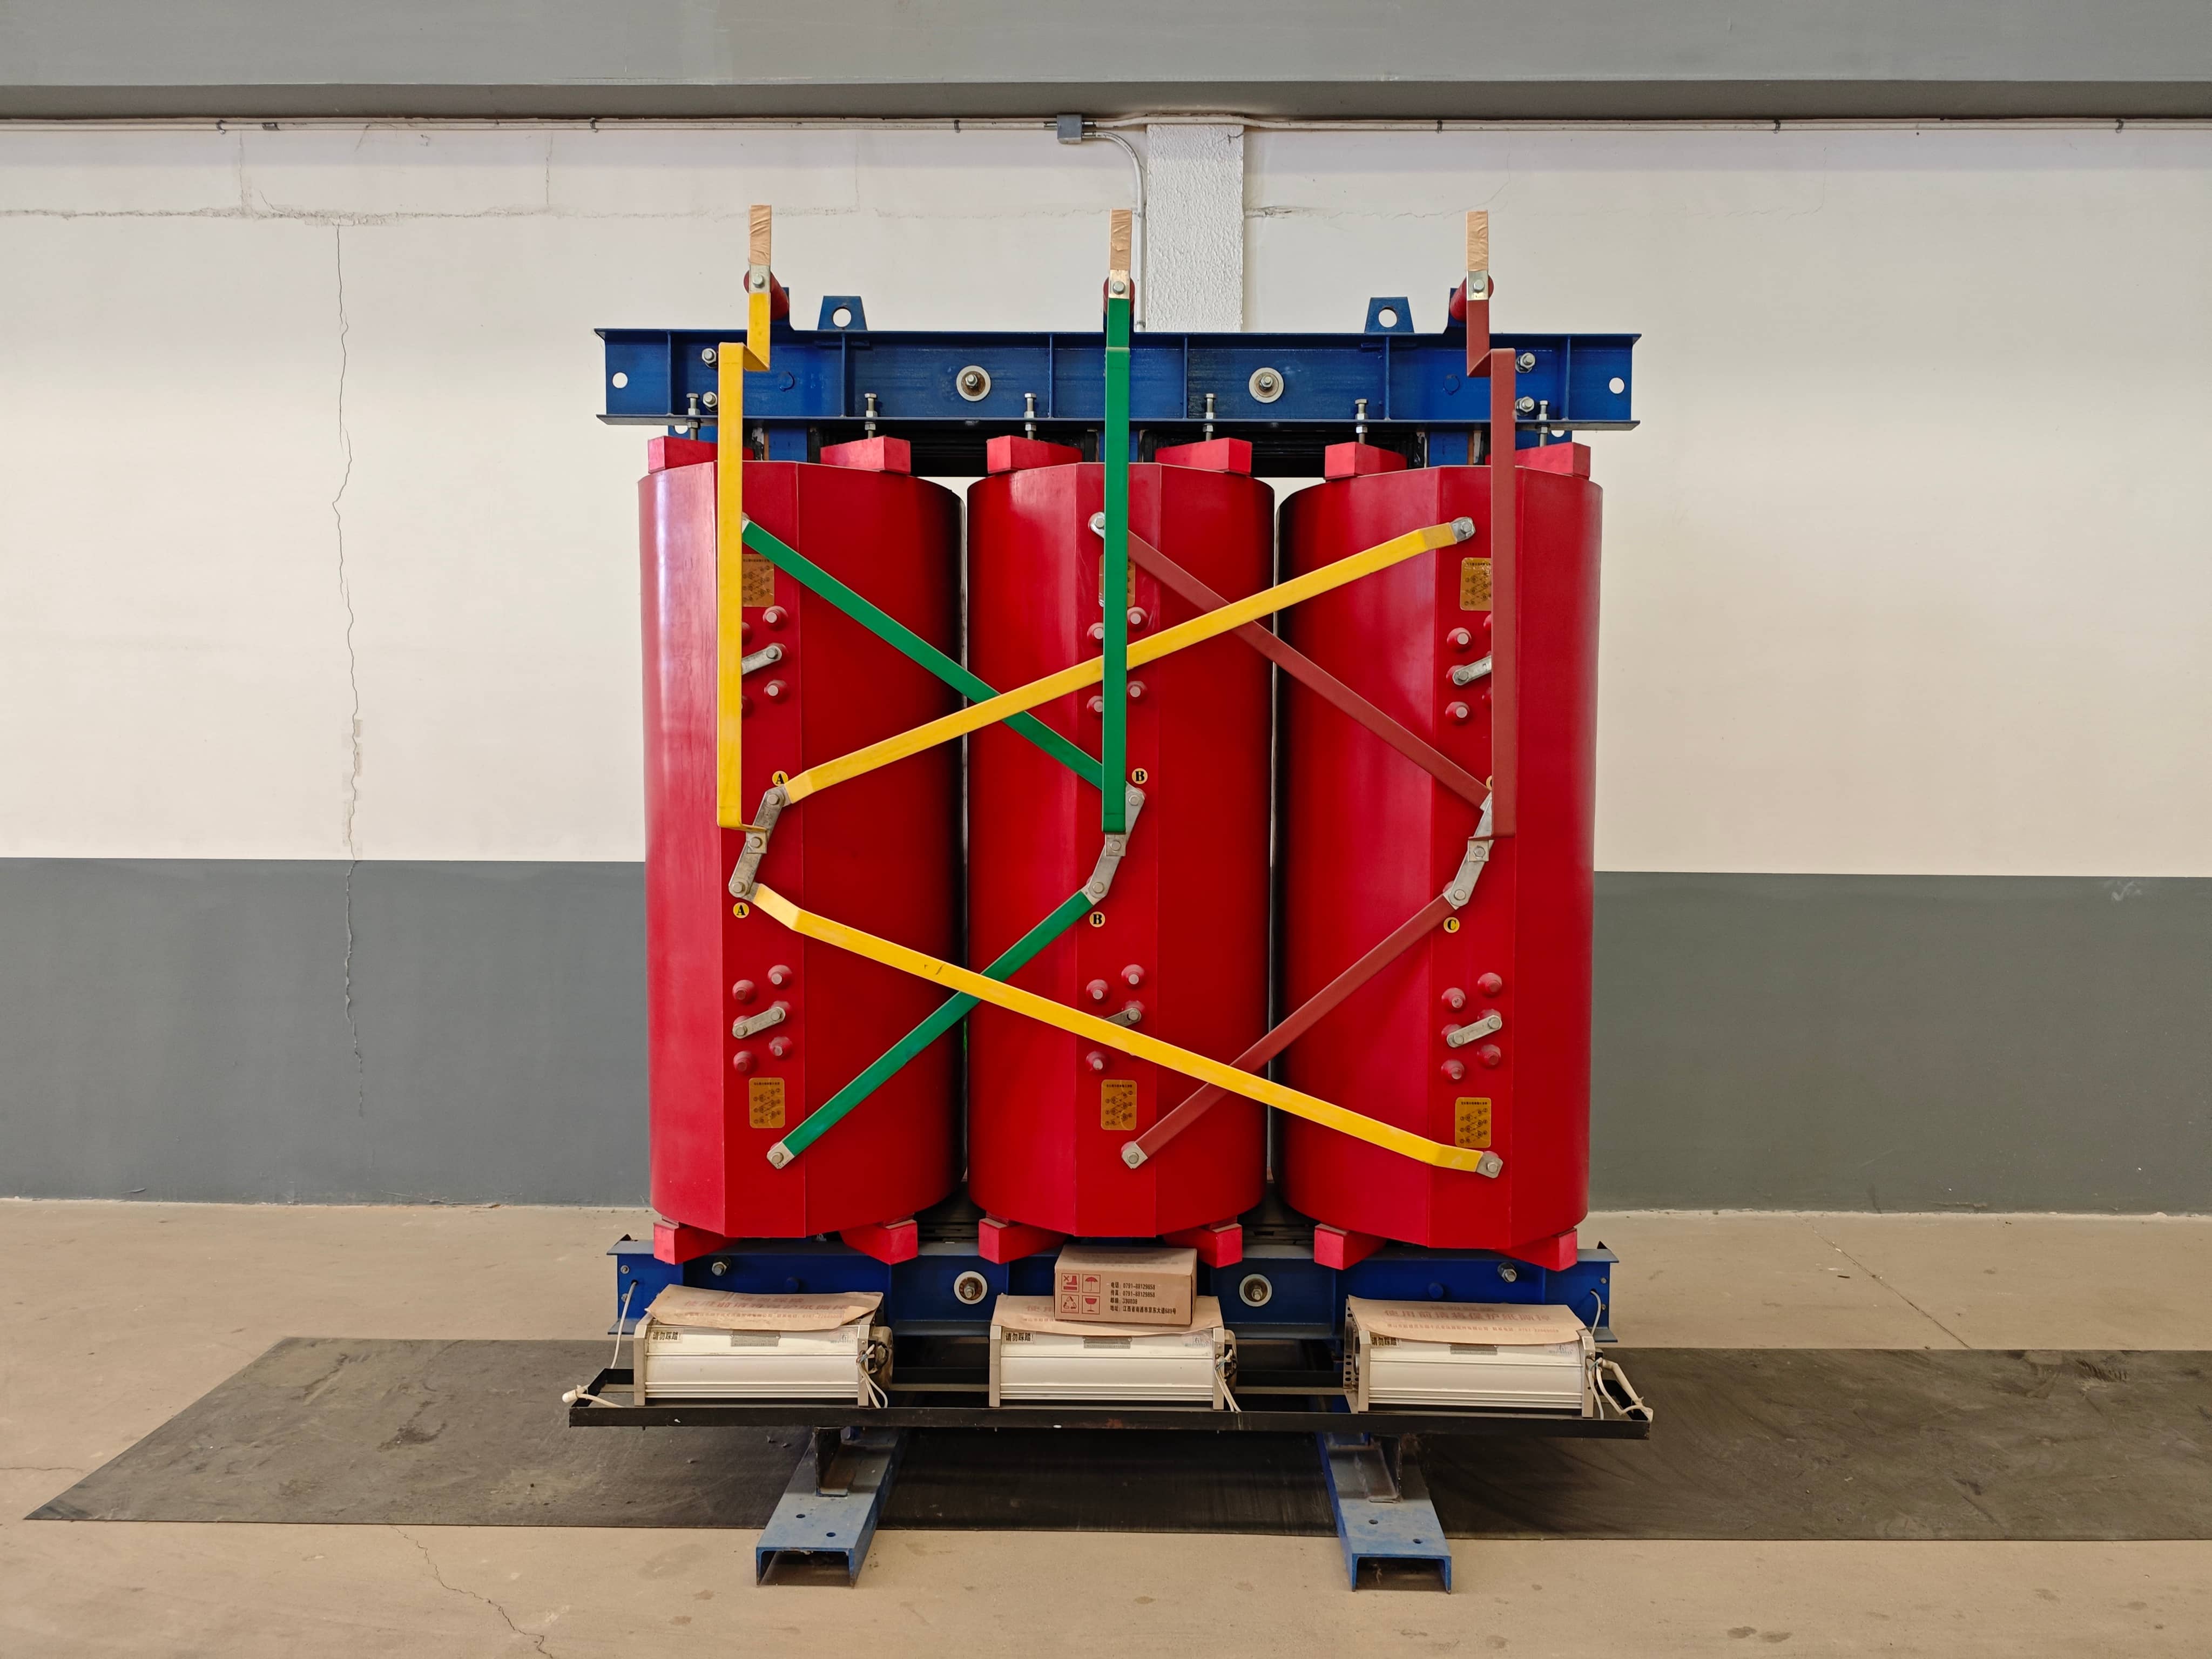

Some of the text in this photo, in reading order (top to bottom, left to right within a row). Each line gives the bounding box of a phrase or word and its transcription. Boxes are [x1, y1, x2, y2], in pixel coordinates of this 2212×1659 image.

[775, 773, 785, 784] A
[1135, 771, 1145, 781] B
[737, 905, 746, 915] A
[1093, 914, 1102, 925] B
[1447, 919, 1456, 930] C
